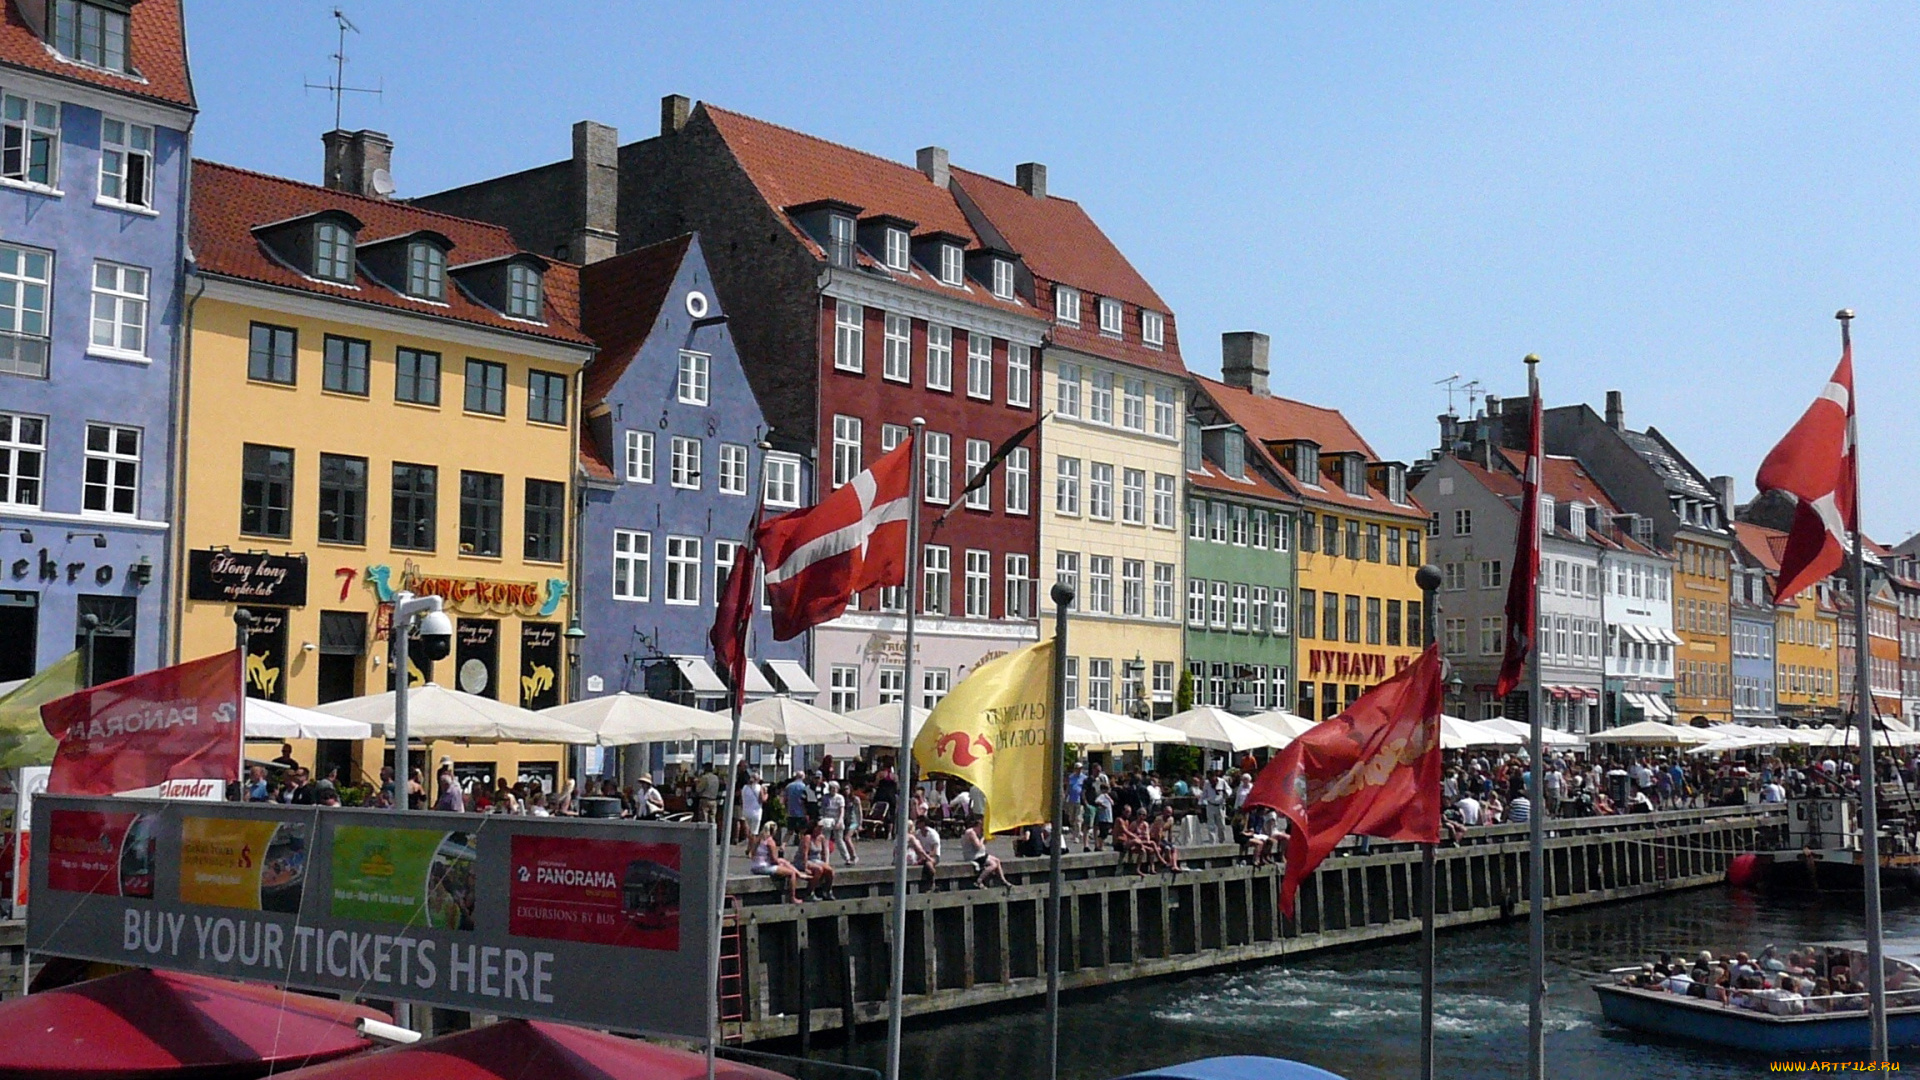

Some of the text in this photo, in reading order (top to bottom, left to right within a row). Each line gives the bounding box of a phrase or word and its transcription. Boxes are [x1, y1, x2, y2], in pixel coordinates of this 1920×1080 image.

[0, 548, 113, 584] ekro
[210, 554, 253, 583] Hong
[223, 582, 273, 599] nightclub
[335, 567, 357, 600] 7
[1309, 650, 1386, 677] NYHAVN
[537, 867, 617, 889] PANORAMA
[517, 906, 615, 925] EXCURSIONS BY BUS
[123, 909, 554, 1003] BUY YOUR TICKETS HERE
